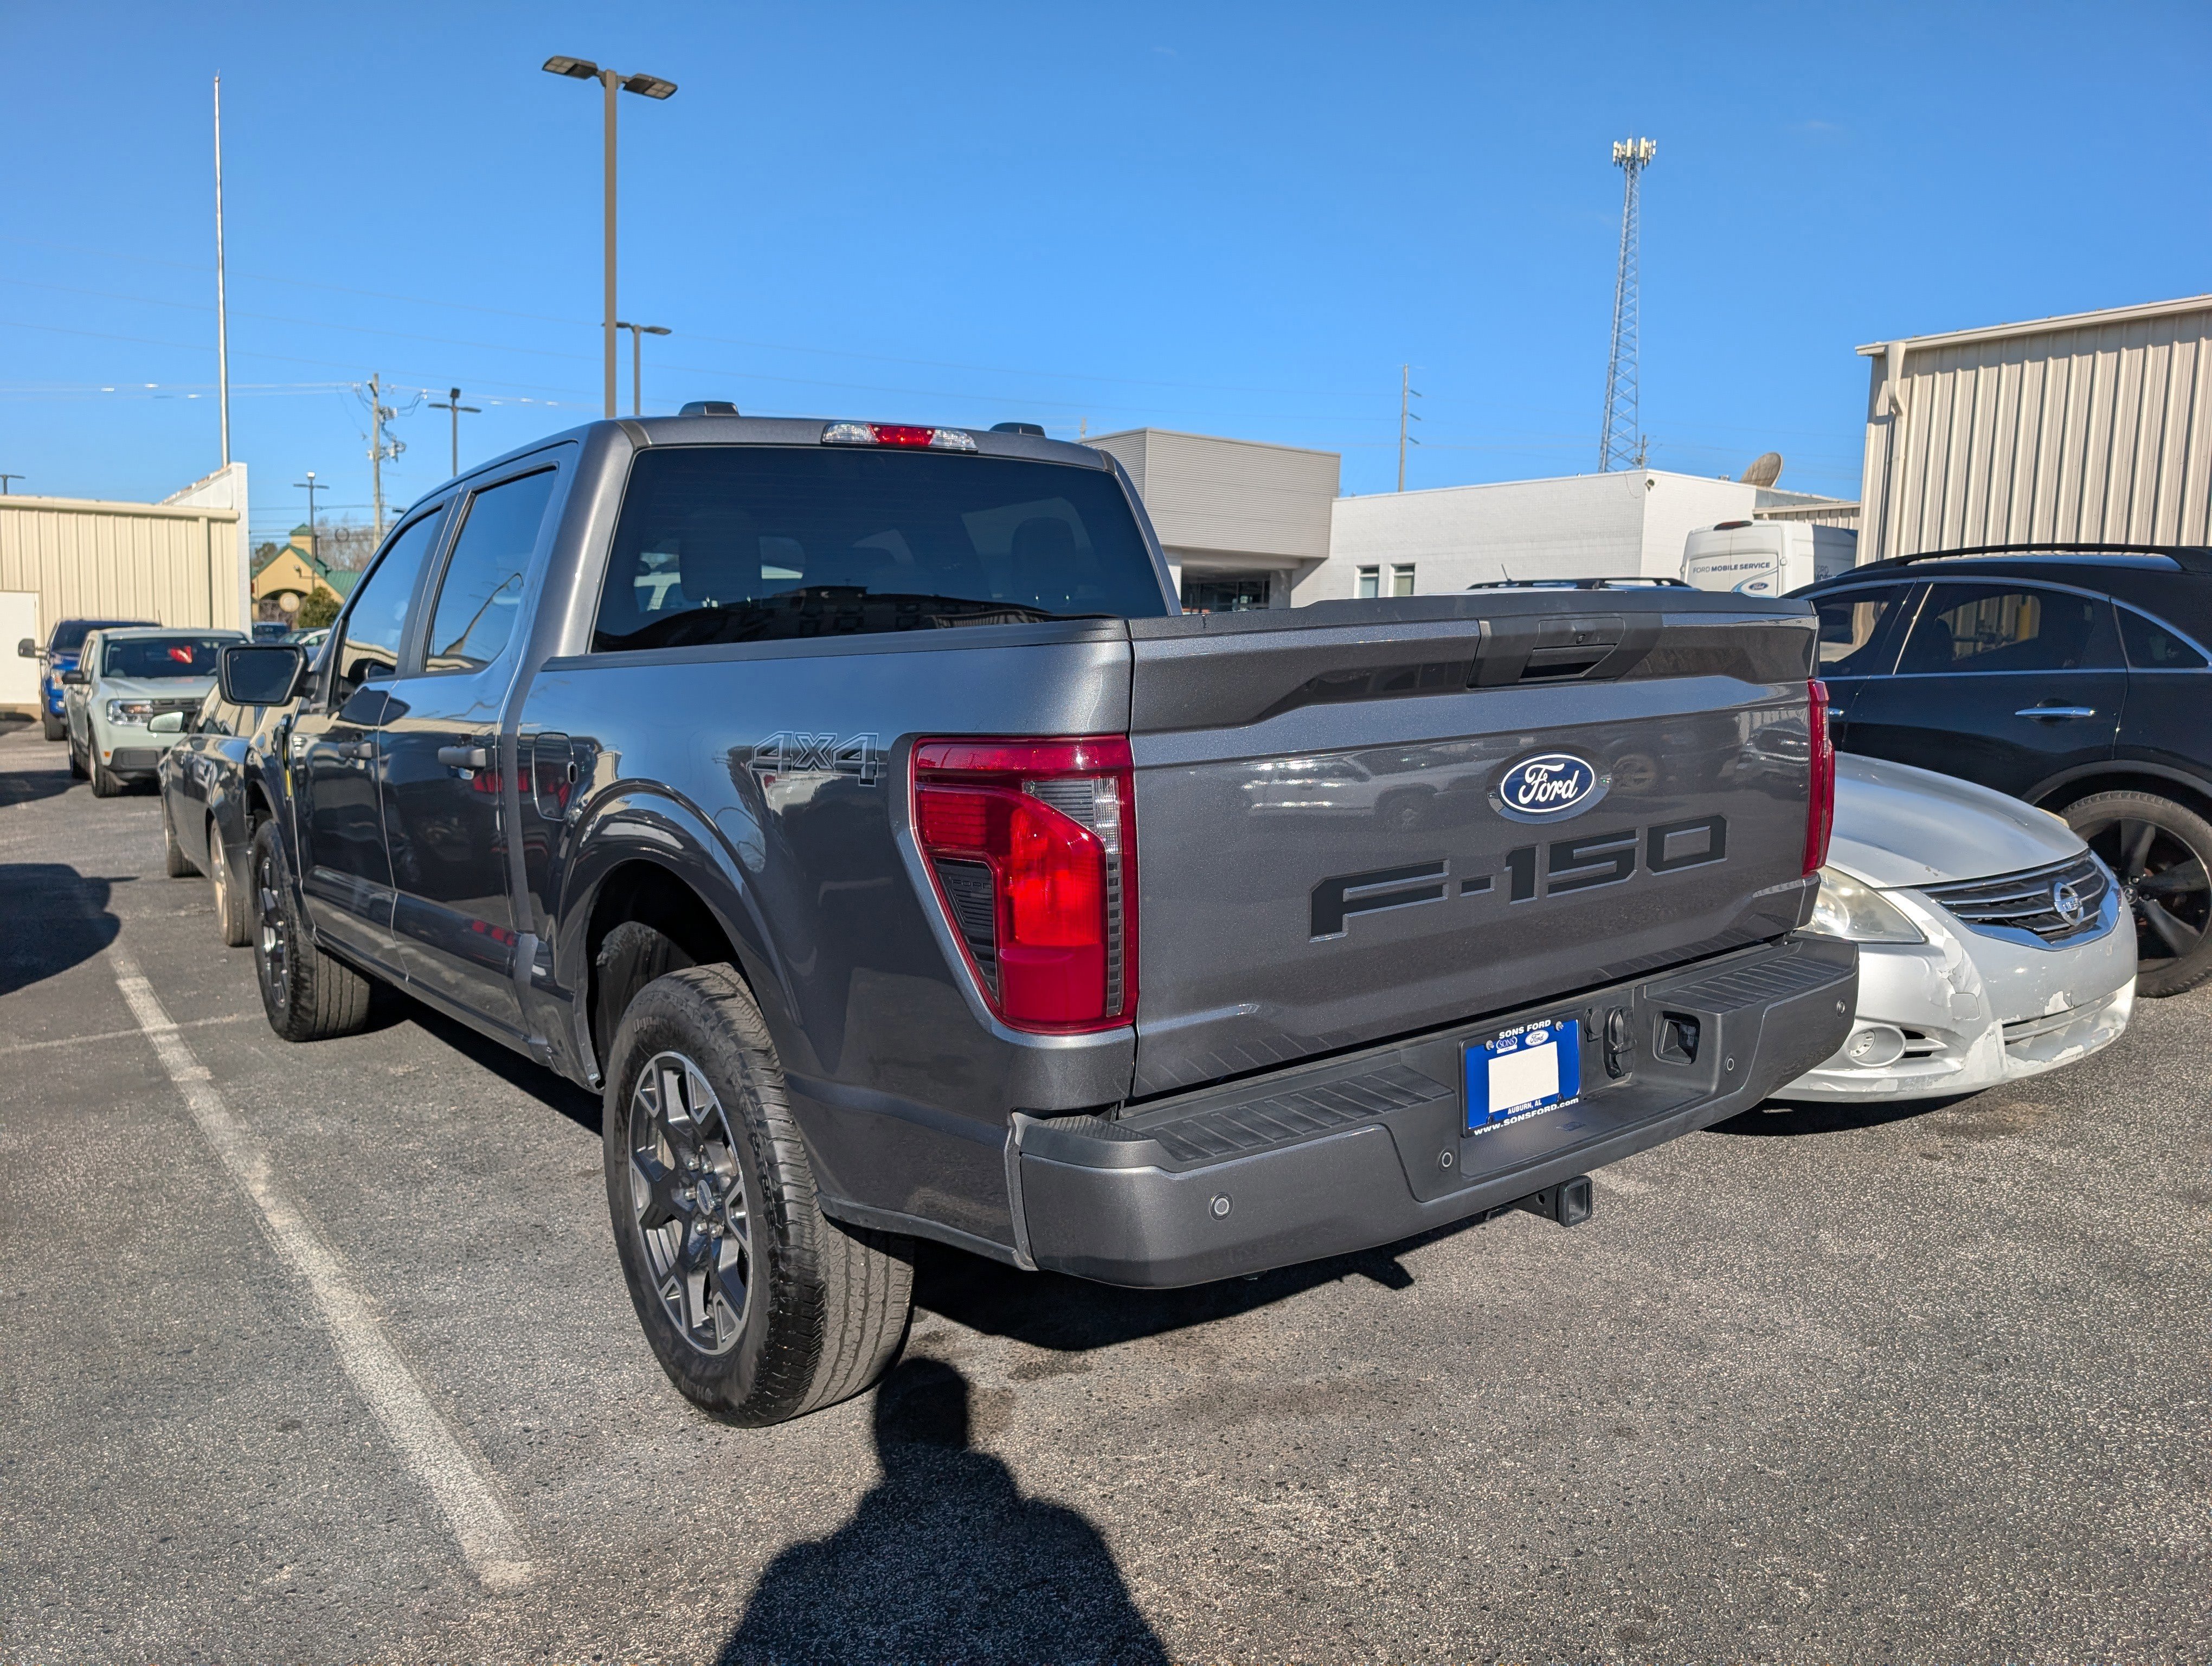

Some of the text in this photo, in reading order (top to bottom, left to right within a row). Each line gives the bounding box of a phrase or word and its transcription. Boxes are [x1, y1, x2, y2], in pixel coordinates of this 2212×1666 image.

[1711, 563, 1738, 572] MOBILE
[1739, 561, 1771, 570] SERVICE
[1519, 762, 1581, 805] Ford
[952, 877, 993, 890] FORD
[1309, 815, 1728, 942] F-150
[1499, 1020, 1551, 1039] SONS FORD
[1500, 1038, 1515, 1048] SONS
[1530, 1033, 1544, 1043] Ford
[1507, 1103, 1533, 1115] AUBURN,
[1474, 1097, 1579, 1136] www.SONSFORD.com
